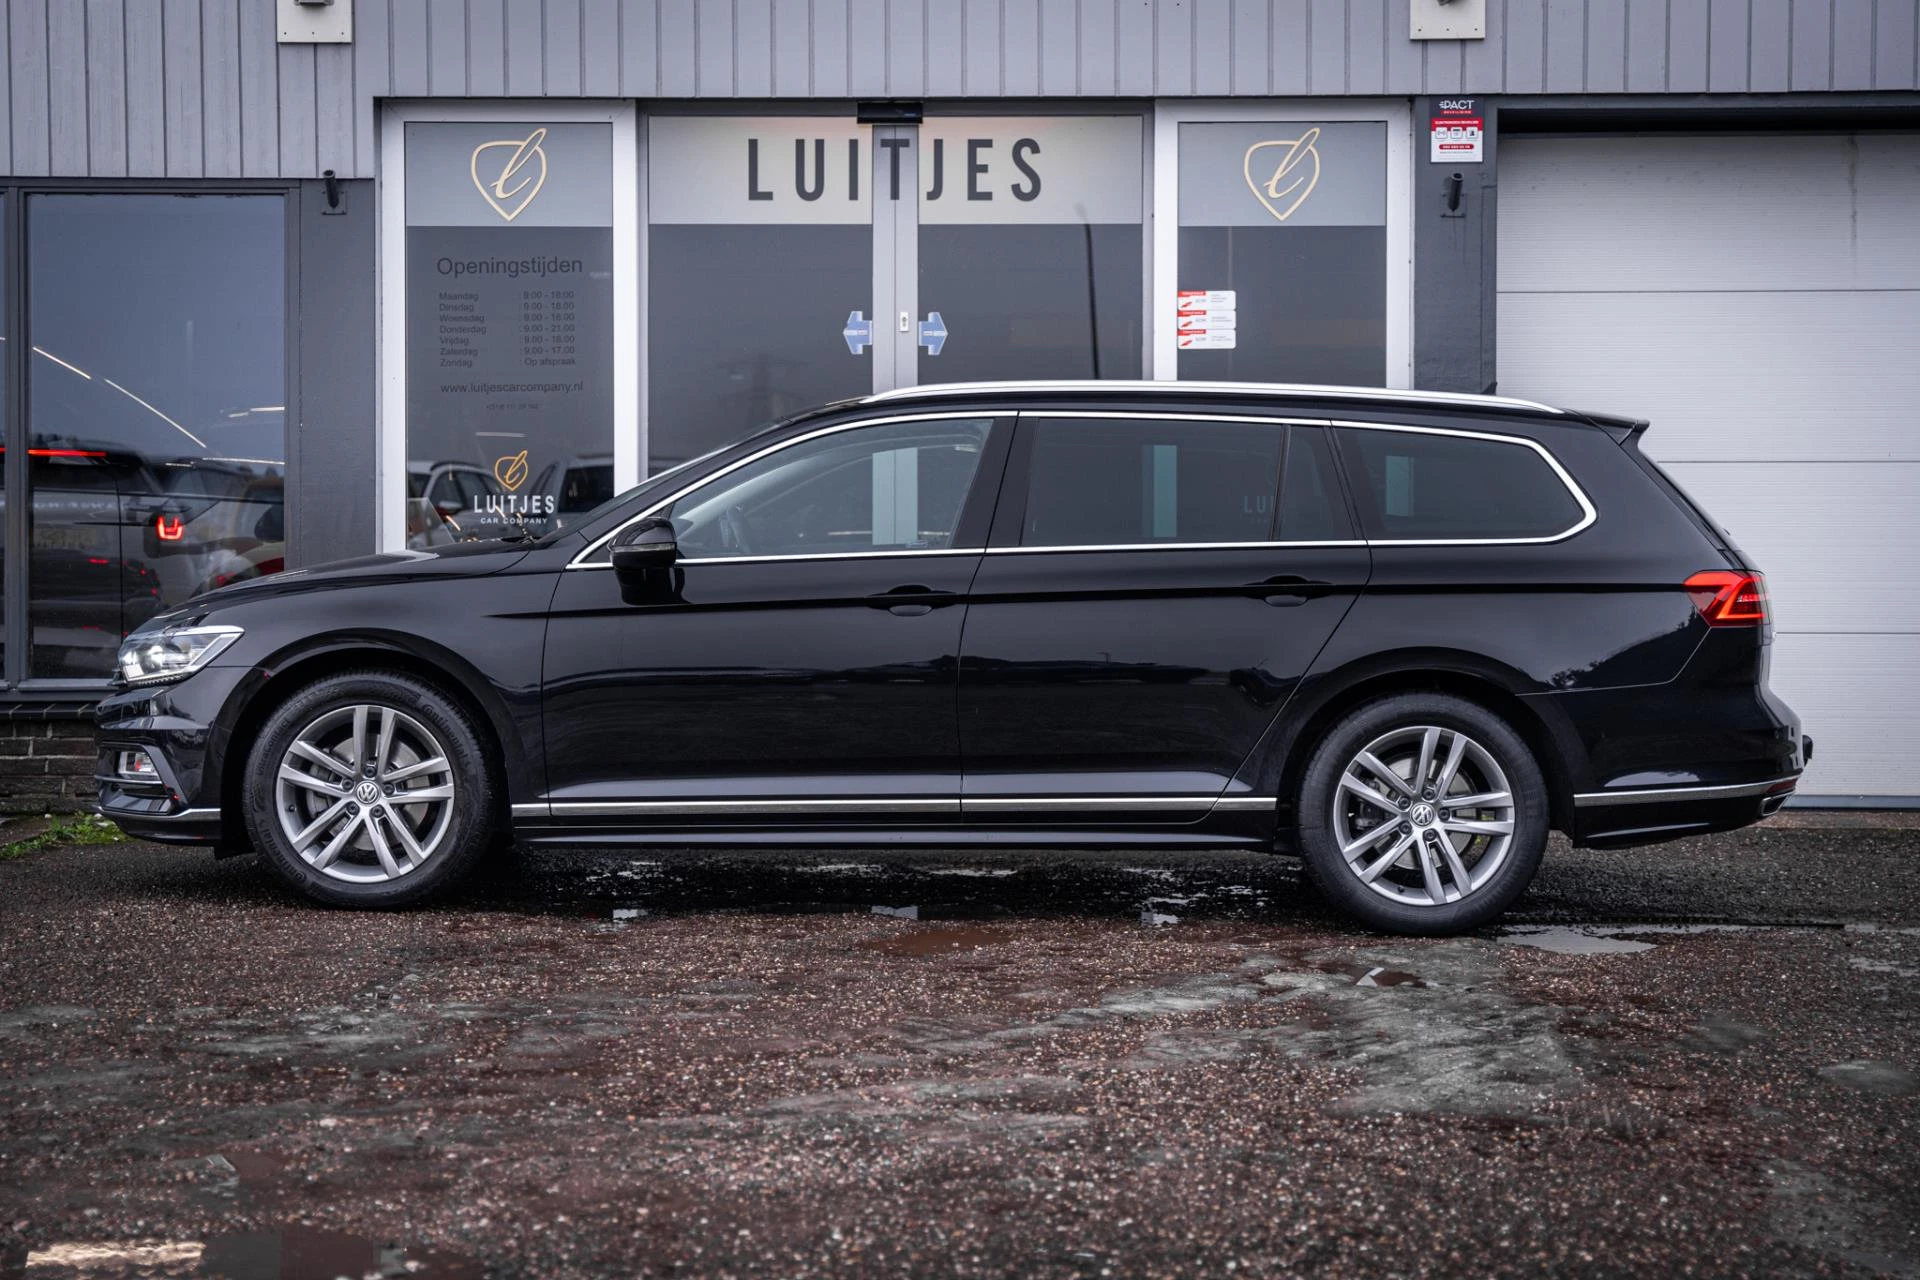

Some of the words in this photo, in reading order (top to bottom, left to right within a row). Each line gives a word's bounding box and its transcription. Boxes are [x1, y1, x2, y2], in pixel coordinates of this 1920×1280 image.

[747, 137, 1042, 202] LUITJES
[436, 256, 584, 279] Openingstijden
[439, 292, 480, 302] Maandag
[439, 314, 486, 324] Woensdag
[439, 325, 487, 335] Donderdag
[439, 358, 473, 368] Zondag
[524, 357, 538, 368] Op
[440, 380, 584, 395] www.luitjescarcompany.nl
[473, 494, 555, 514] LUITJES
[480, 517, 499, 525] CAR
[503, 517, 548, 525] COMPANY
